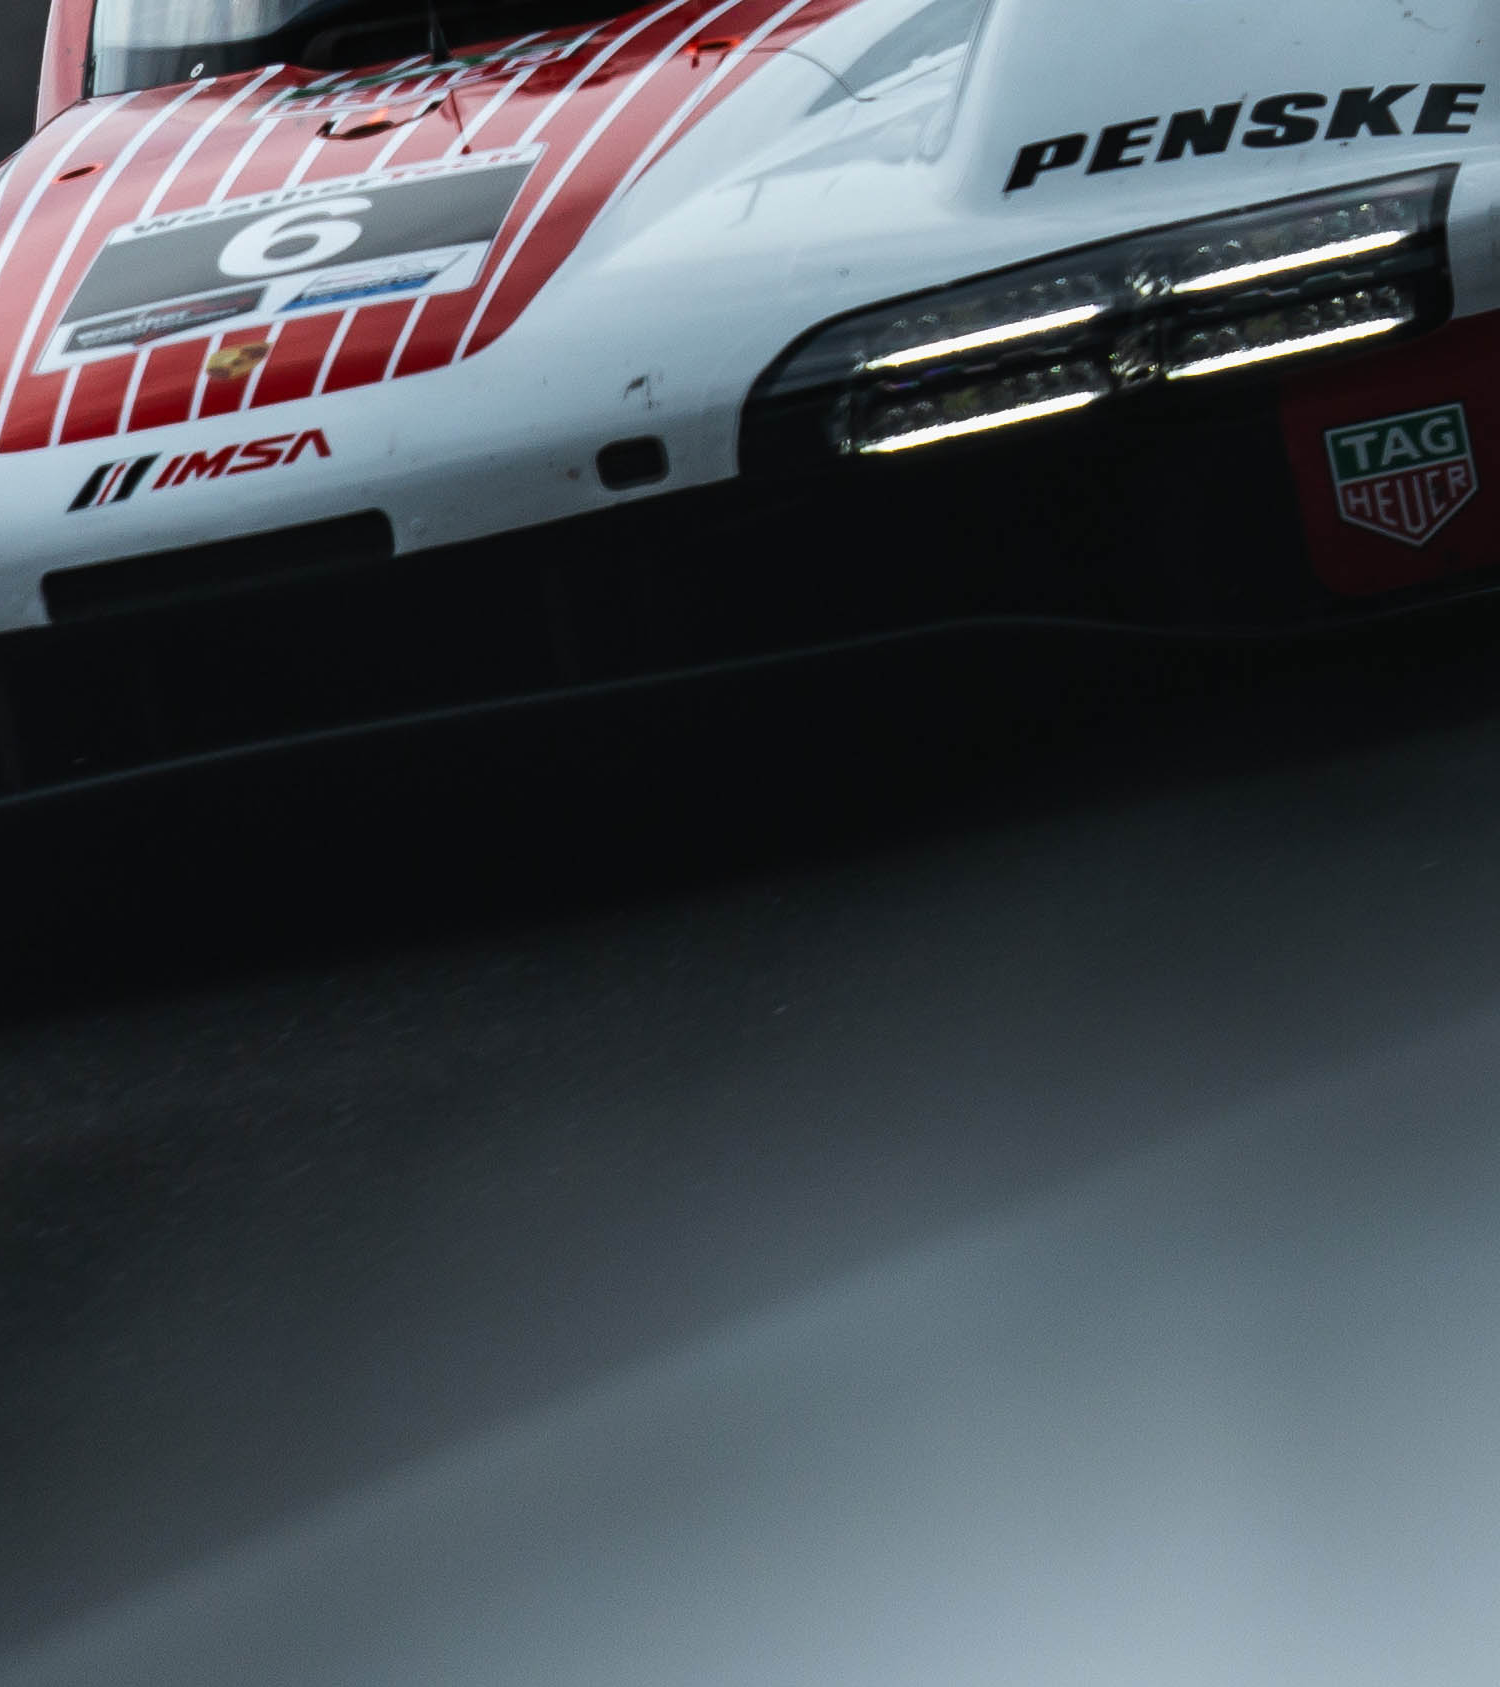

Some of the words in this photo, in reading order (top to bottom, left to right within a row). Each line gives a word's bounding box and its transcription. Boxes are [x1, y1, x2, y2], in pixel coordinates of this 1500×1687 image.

[1002, 82, 1486, 193] PENSKE
[217, 195, 373, 278] 6
[151, 428, 332, 492] IMSA
[1339, 415, 1458, 471] TAG
[1345, 464, 1469, 535] HEUER
